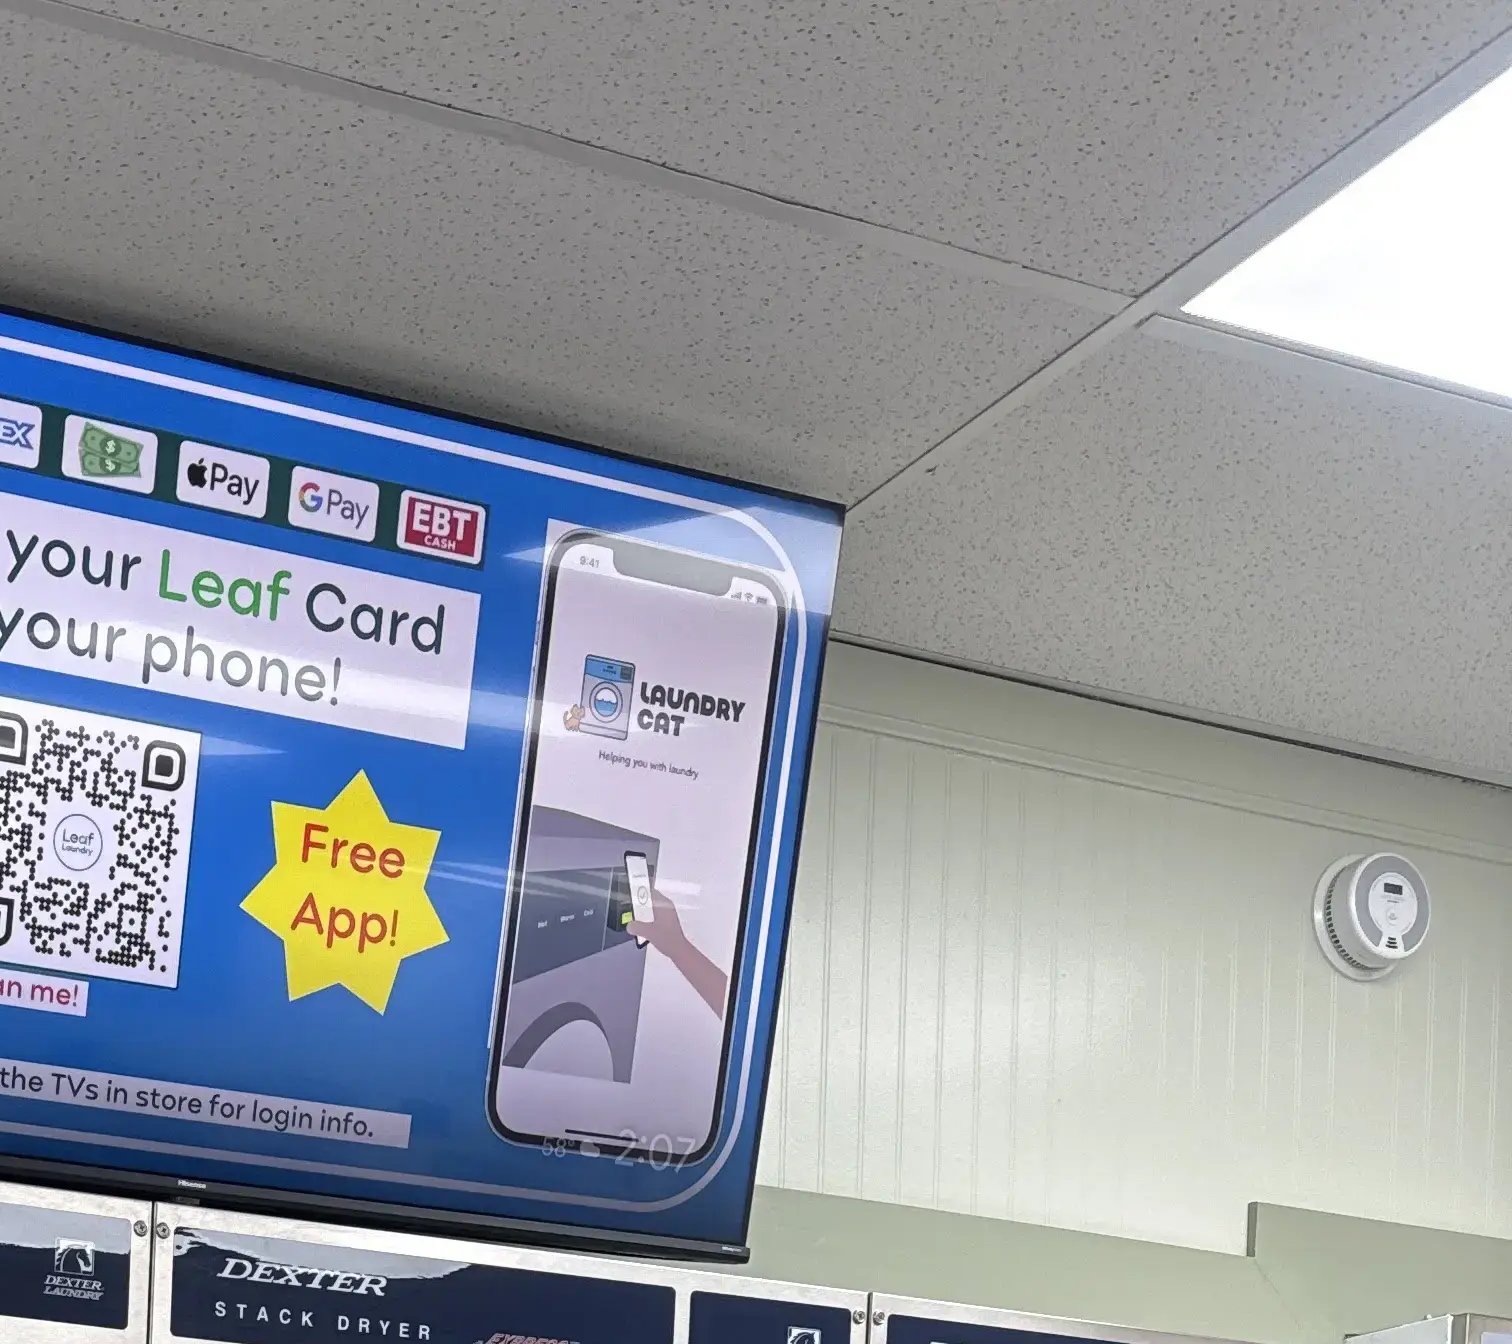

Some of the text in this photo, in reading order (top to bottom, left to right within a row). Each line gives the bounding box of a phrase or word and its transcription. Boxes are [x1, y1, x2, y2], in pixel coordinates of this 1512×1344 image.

[210, 464, 259, 505] Pay
[326, 489, 370, 529] Pay
[411, 499, 472, 541] EBT
[424, 534, 456, 552] CASH
[580, 556, 600, 568] 9:41
[7, 529, 141, 590] your
[158, 549, 291, 621] Leaf
[305, 583, 444, 655] Card
[141, 626, 341, 706] phone!
[640, 682, 746, 722] LAUNDRY
[638, 709, 685, 736] CAT
[599, 750, 699, 780] Helping you with laundry
[63, 829, 94, 846] Leaf
[301, 823, 406, 879] Free
[289, 892, 400, 953] App!
[30, 982, 79, 1007] me!
[0, 1067, 44, 1092] the
[51, 1073, 99, 1101] TVs
[105, 1080, 128, 1103] in
[136, 1087, 202, 1114] store
[209, 1095, 245, 1121] for
[252, 1100, 312, 1132] login
[320, 1109, 374, 1138] info.
[615, 1128, 696, 1173] 2:07
[43, 1274, 102, 1291] DEXTER
[43, 1286, 104, 1300] LAUNDRY
[216, 1258, 388, 1297] DEXTER
[214, 1301, 431, 1340] STACK DRYER
